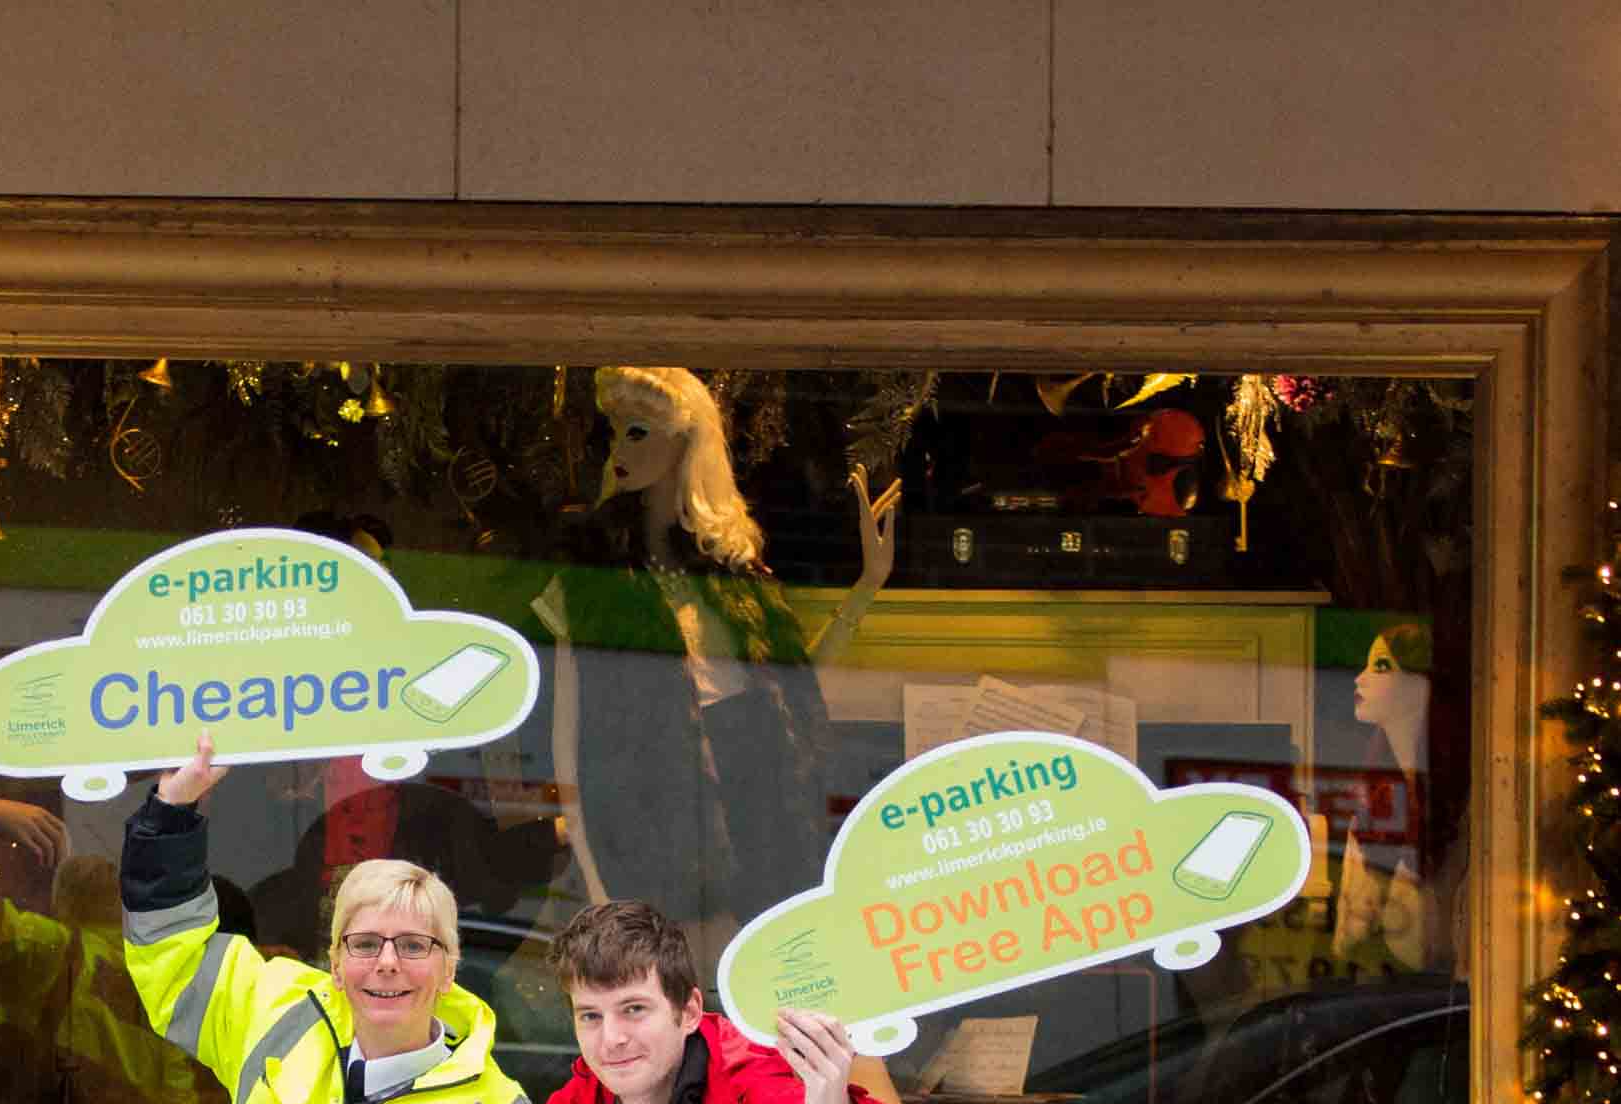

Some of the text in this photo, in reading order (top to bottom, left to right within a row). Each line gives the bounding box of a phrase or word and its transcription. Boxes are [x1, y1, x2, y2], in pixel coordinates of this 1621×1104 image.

[148, 556, 339, 602] e-parking
[136, 619, 353, 651] www.limerickparking.ie
[180, 597, 308, 626] 061 30 30 93
[90, 667, 406, 731] Cheaper
[881, 753, 1077, 829] e-parking
[885, 816, 1107, 889] www.limerickparking.ie
[922, 799, 1054, 855] 061 30 30 93
[862, 828, 1154, 949] Download
[890, 892, 1153, 993] Free App
